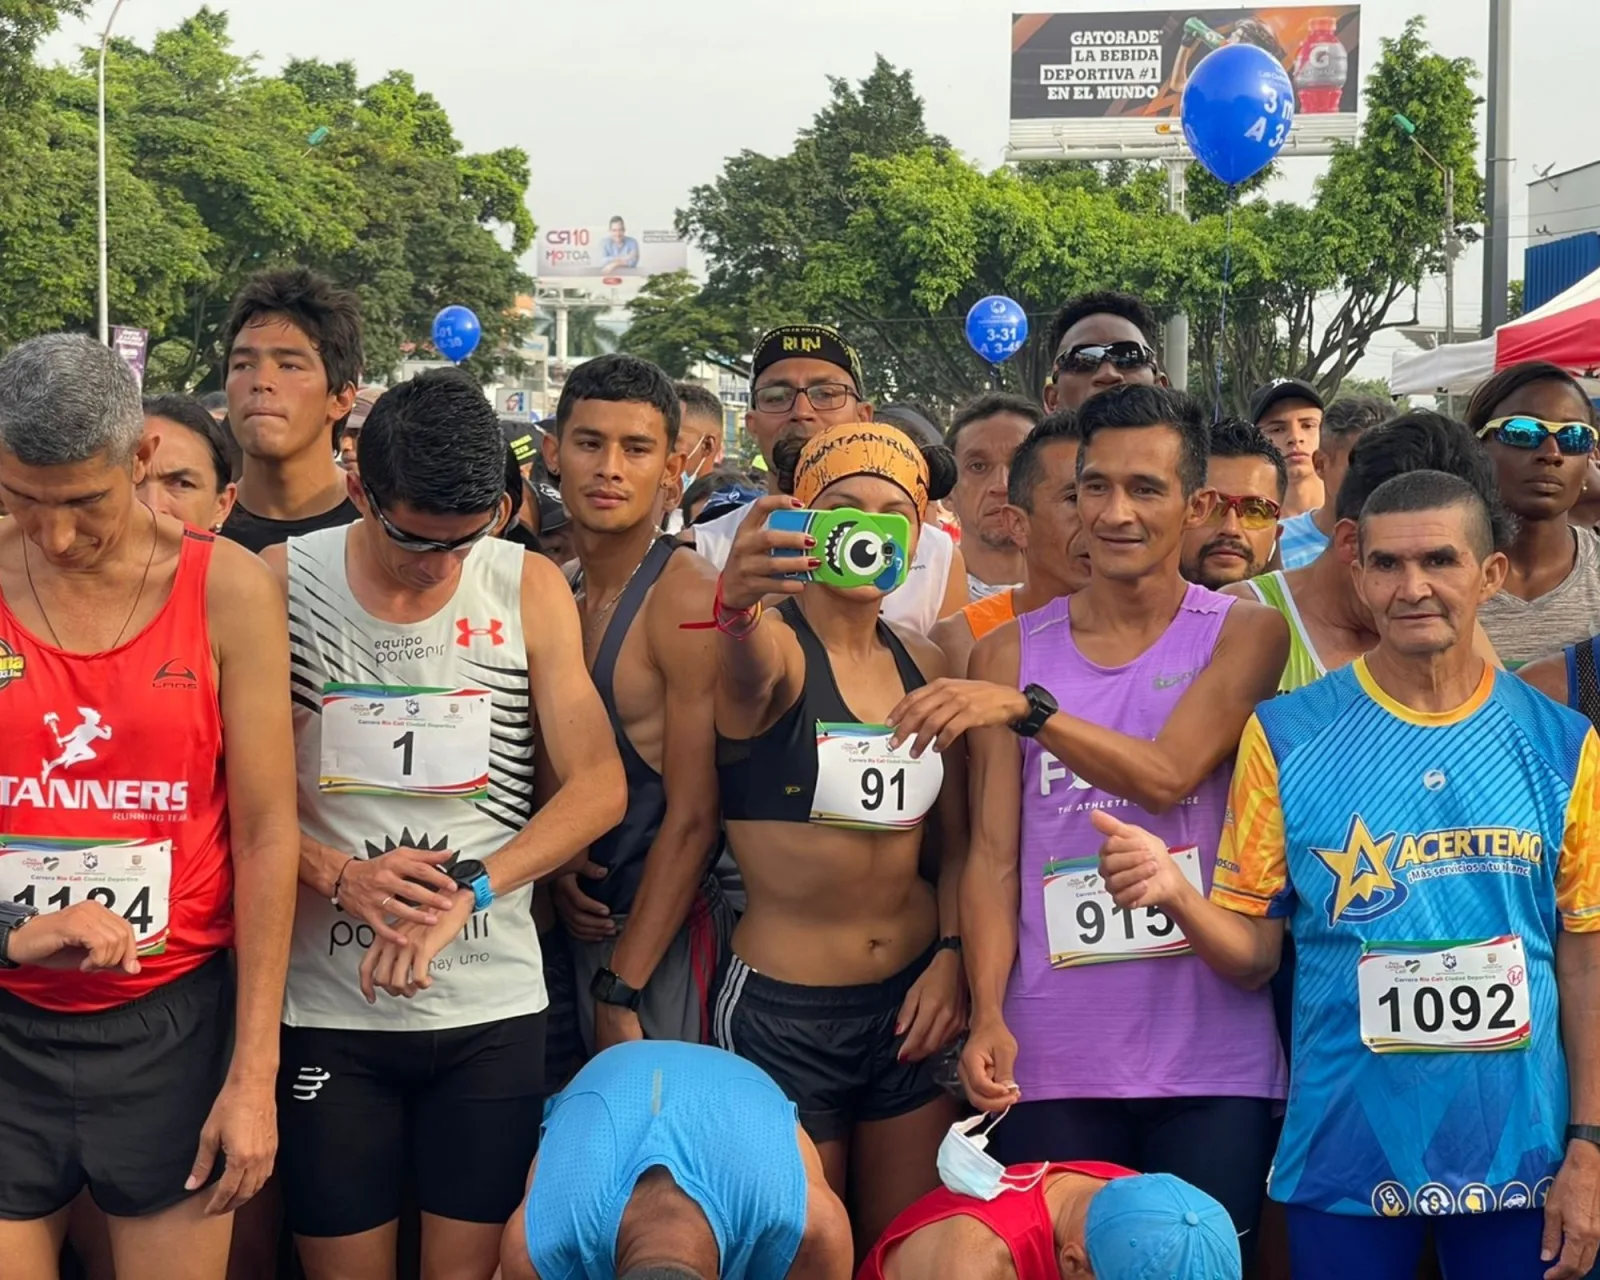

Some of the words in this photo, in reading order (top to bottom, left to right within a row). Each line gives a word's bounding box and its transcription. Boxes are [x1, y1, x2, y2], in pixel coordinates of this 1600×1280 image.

[1070, 30, 1160, 45] GATORADE
[1075, 50, 1096, 62] LA
[1100, 49, 1159, 62] BEBIDA
[1043, 67, 1135, 81] DEPORTIVA
[1139, 67, 1157, 80] #1
[1047, 86, 1071, 100] EN
[1073, 86, 1093, 100] EL
[1097, 85, 1159, 99] MUNDO
[1262, 84, 1278, 113] 3
[1244, 116, 1267, 142] A
[986, 327, 1017, 341] 3-31
[980, 342, 990, 353] A
[373, 635, 423, 651] equipo
[375, 643, 446, 668] porvenir
[393, 730, 415, 776] 1
[861, 767, 905, 811] 91
[1076, 799, 1129, 812] ATHLETE
[112, 812, 165, 822] RUNNING
[1433, 861, 1479, 877] servicios
[1489, 861, 1500, 871] tu
[1076, 900, 1175, 945] 915
[459, 950, 490, 966] uno
[1378, 983, 1516, 1033] 1092
